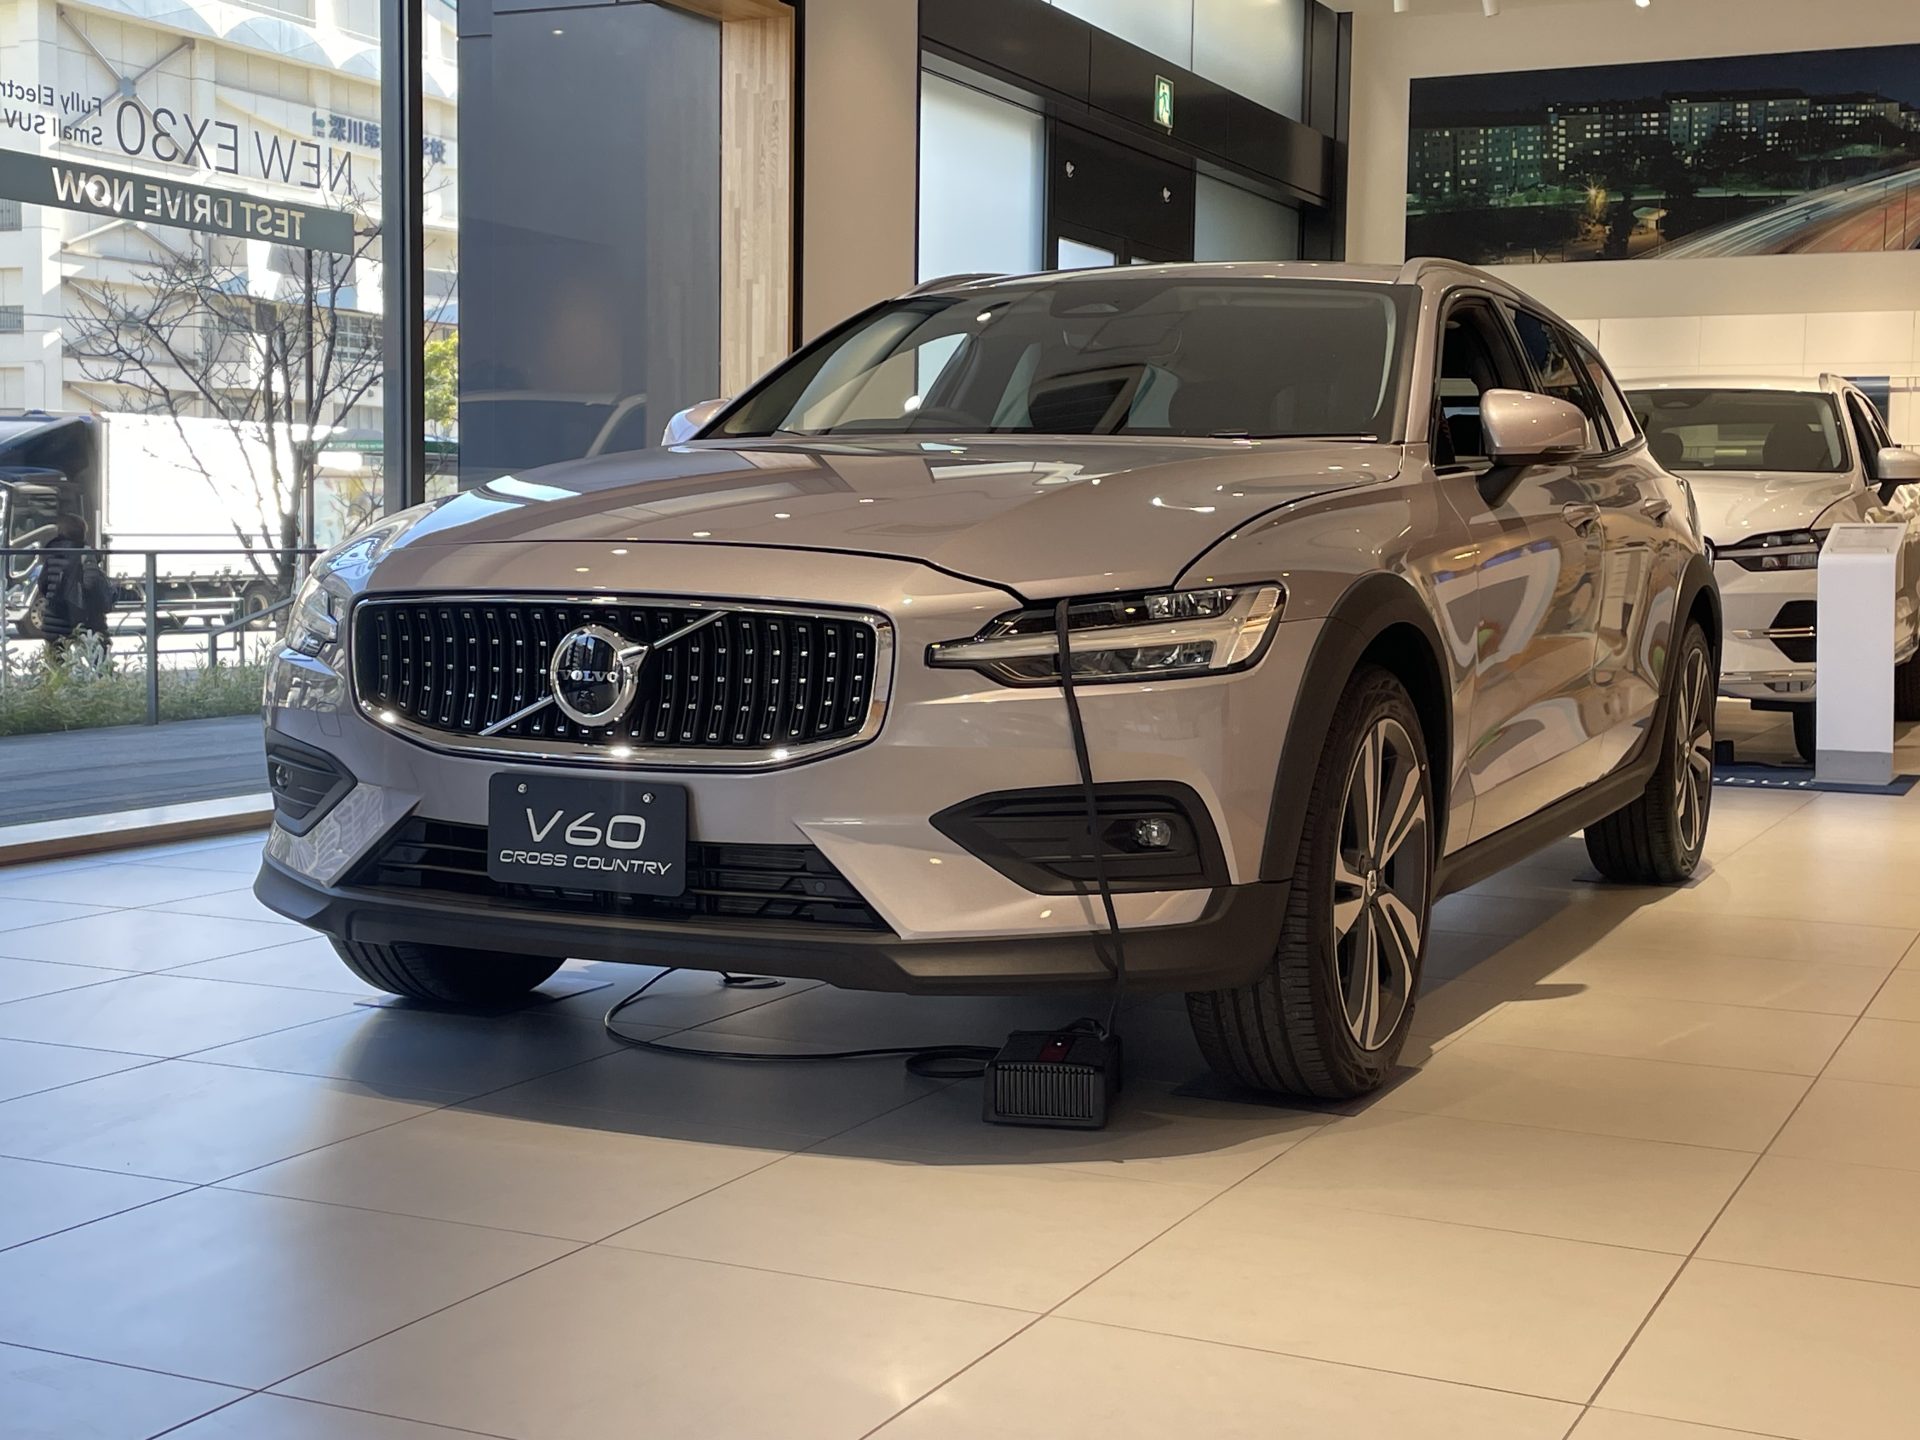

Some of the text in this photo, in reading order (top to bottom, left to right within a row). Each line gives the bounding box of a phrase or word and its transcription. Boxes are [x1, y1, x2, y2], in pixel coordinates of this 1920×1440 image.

[559, 669, 619, 683] VOLVO
[526, 808, 647, 850] V60
[499, 850, 672, 876] CROSS COUNTRY
